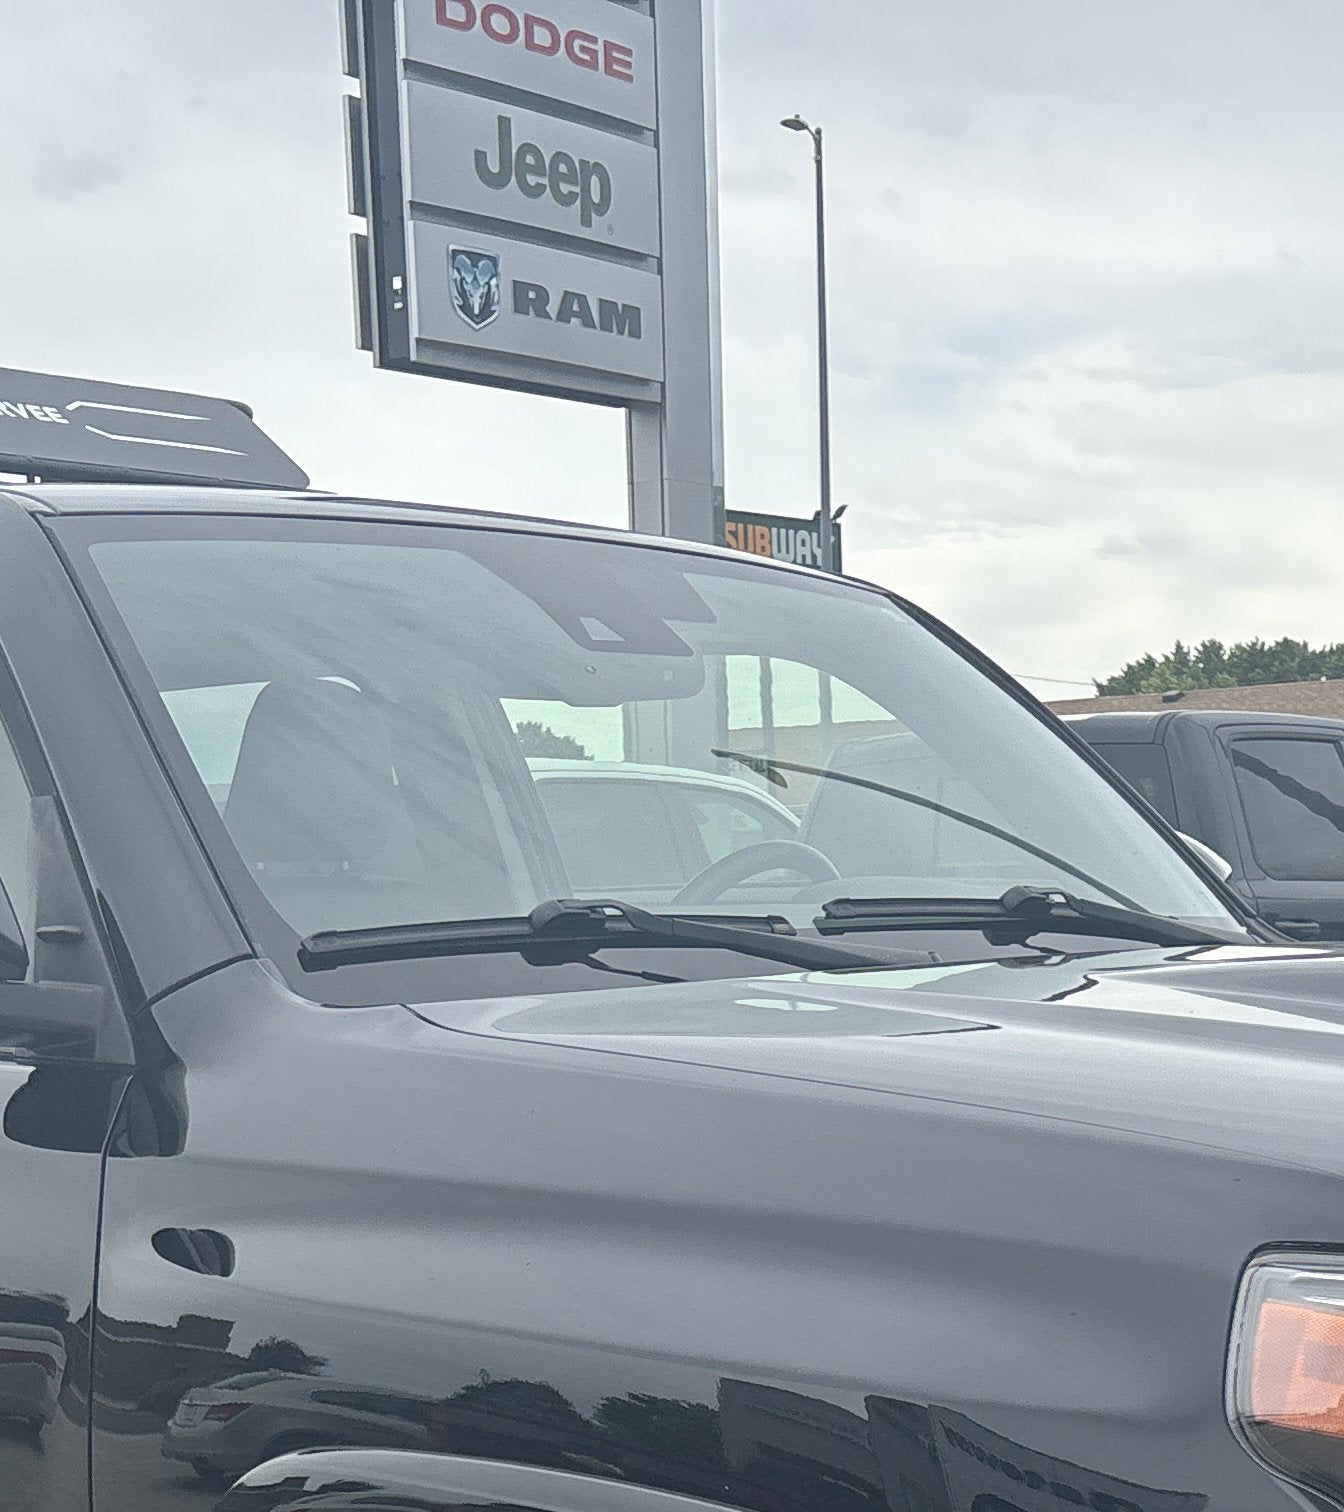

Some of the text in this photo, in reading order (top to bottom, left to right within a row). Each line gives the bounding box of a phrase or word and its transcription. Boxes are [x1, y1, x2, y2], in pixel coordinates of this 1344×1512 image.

[434, 0, 634, 83] DODGE
[473, 114, 612, 228] Jeep
[511, 278, 643, 340] RAM
